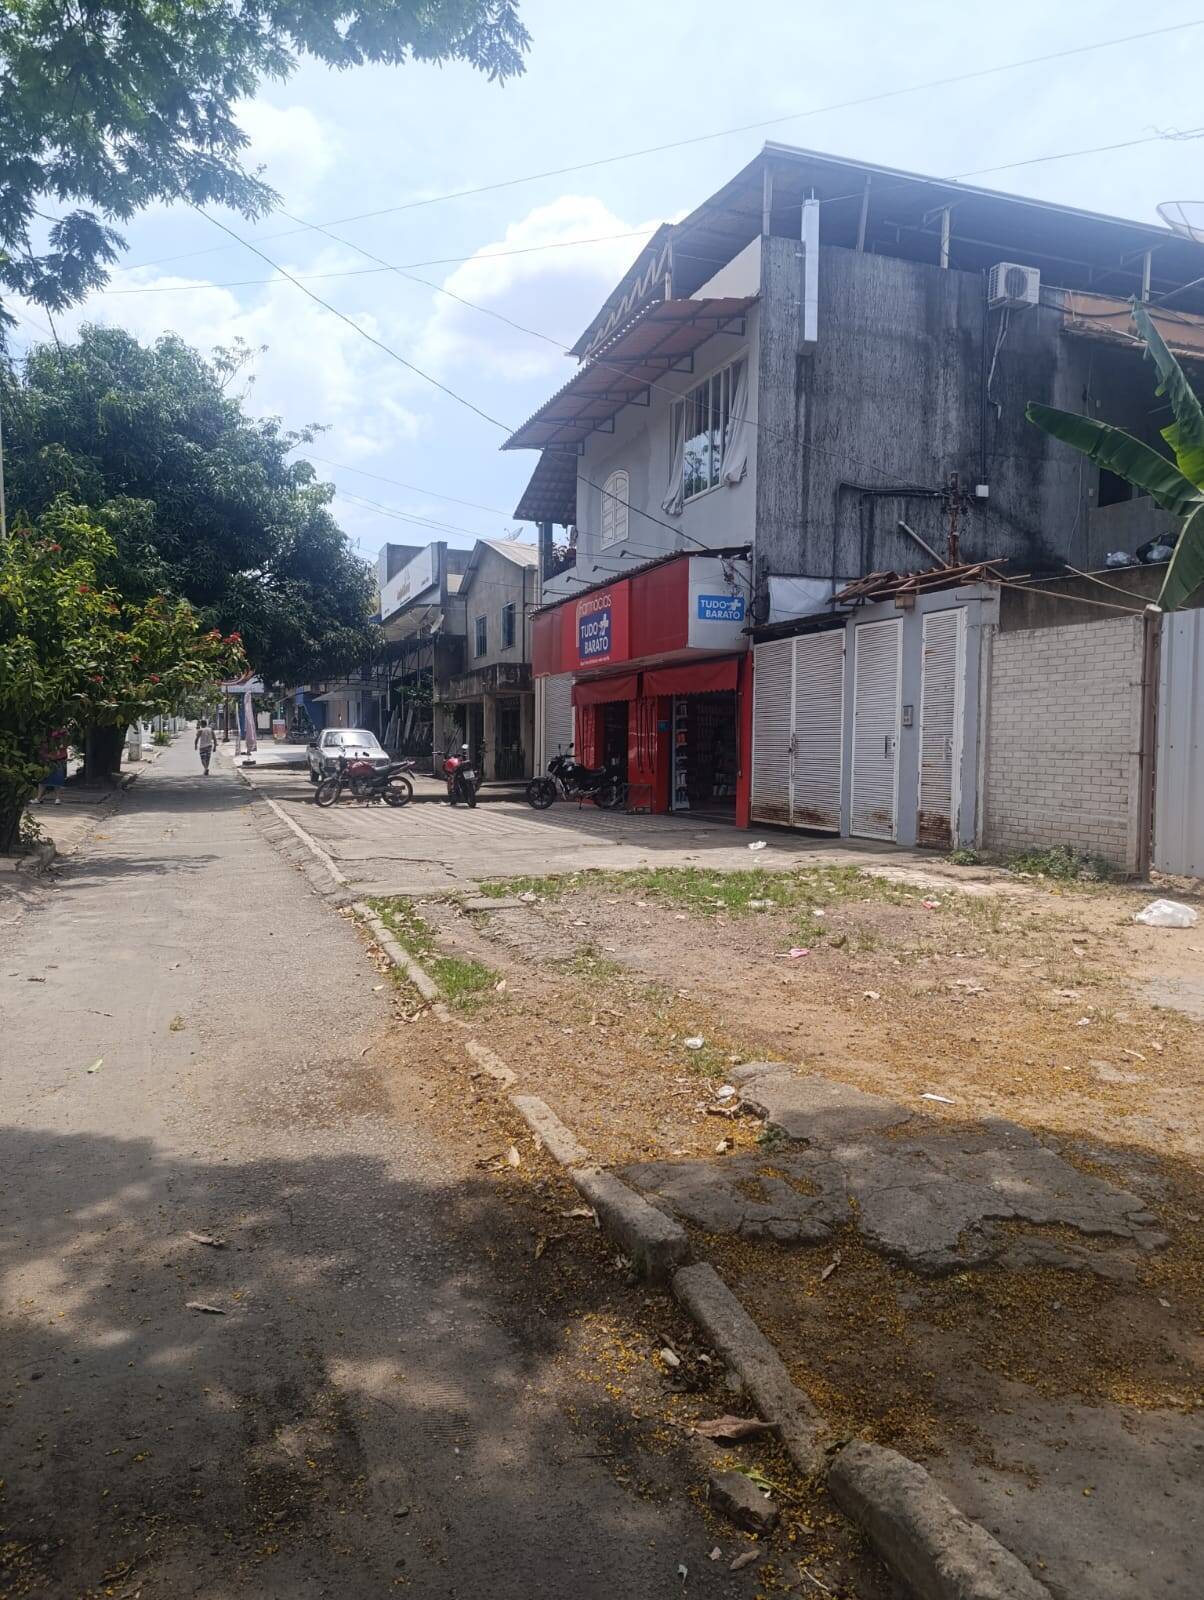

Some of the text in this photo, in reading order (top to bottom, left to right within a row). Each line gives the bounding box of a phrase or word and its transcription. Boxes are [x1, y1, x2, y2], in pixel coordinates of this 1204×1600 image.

[701, 599, 727, 609] TUDO
[706, 609, 741, 619] BARATO
[580, 622, 598, 639] TUDO
[584, 636, 609, 655] BARATO
